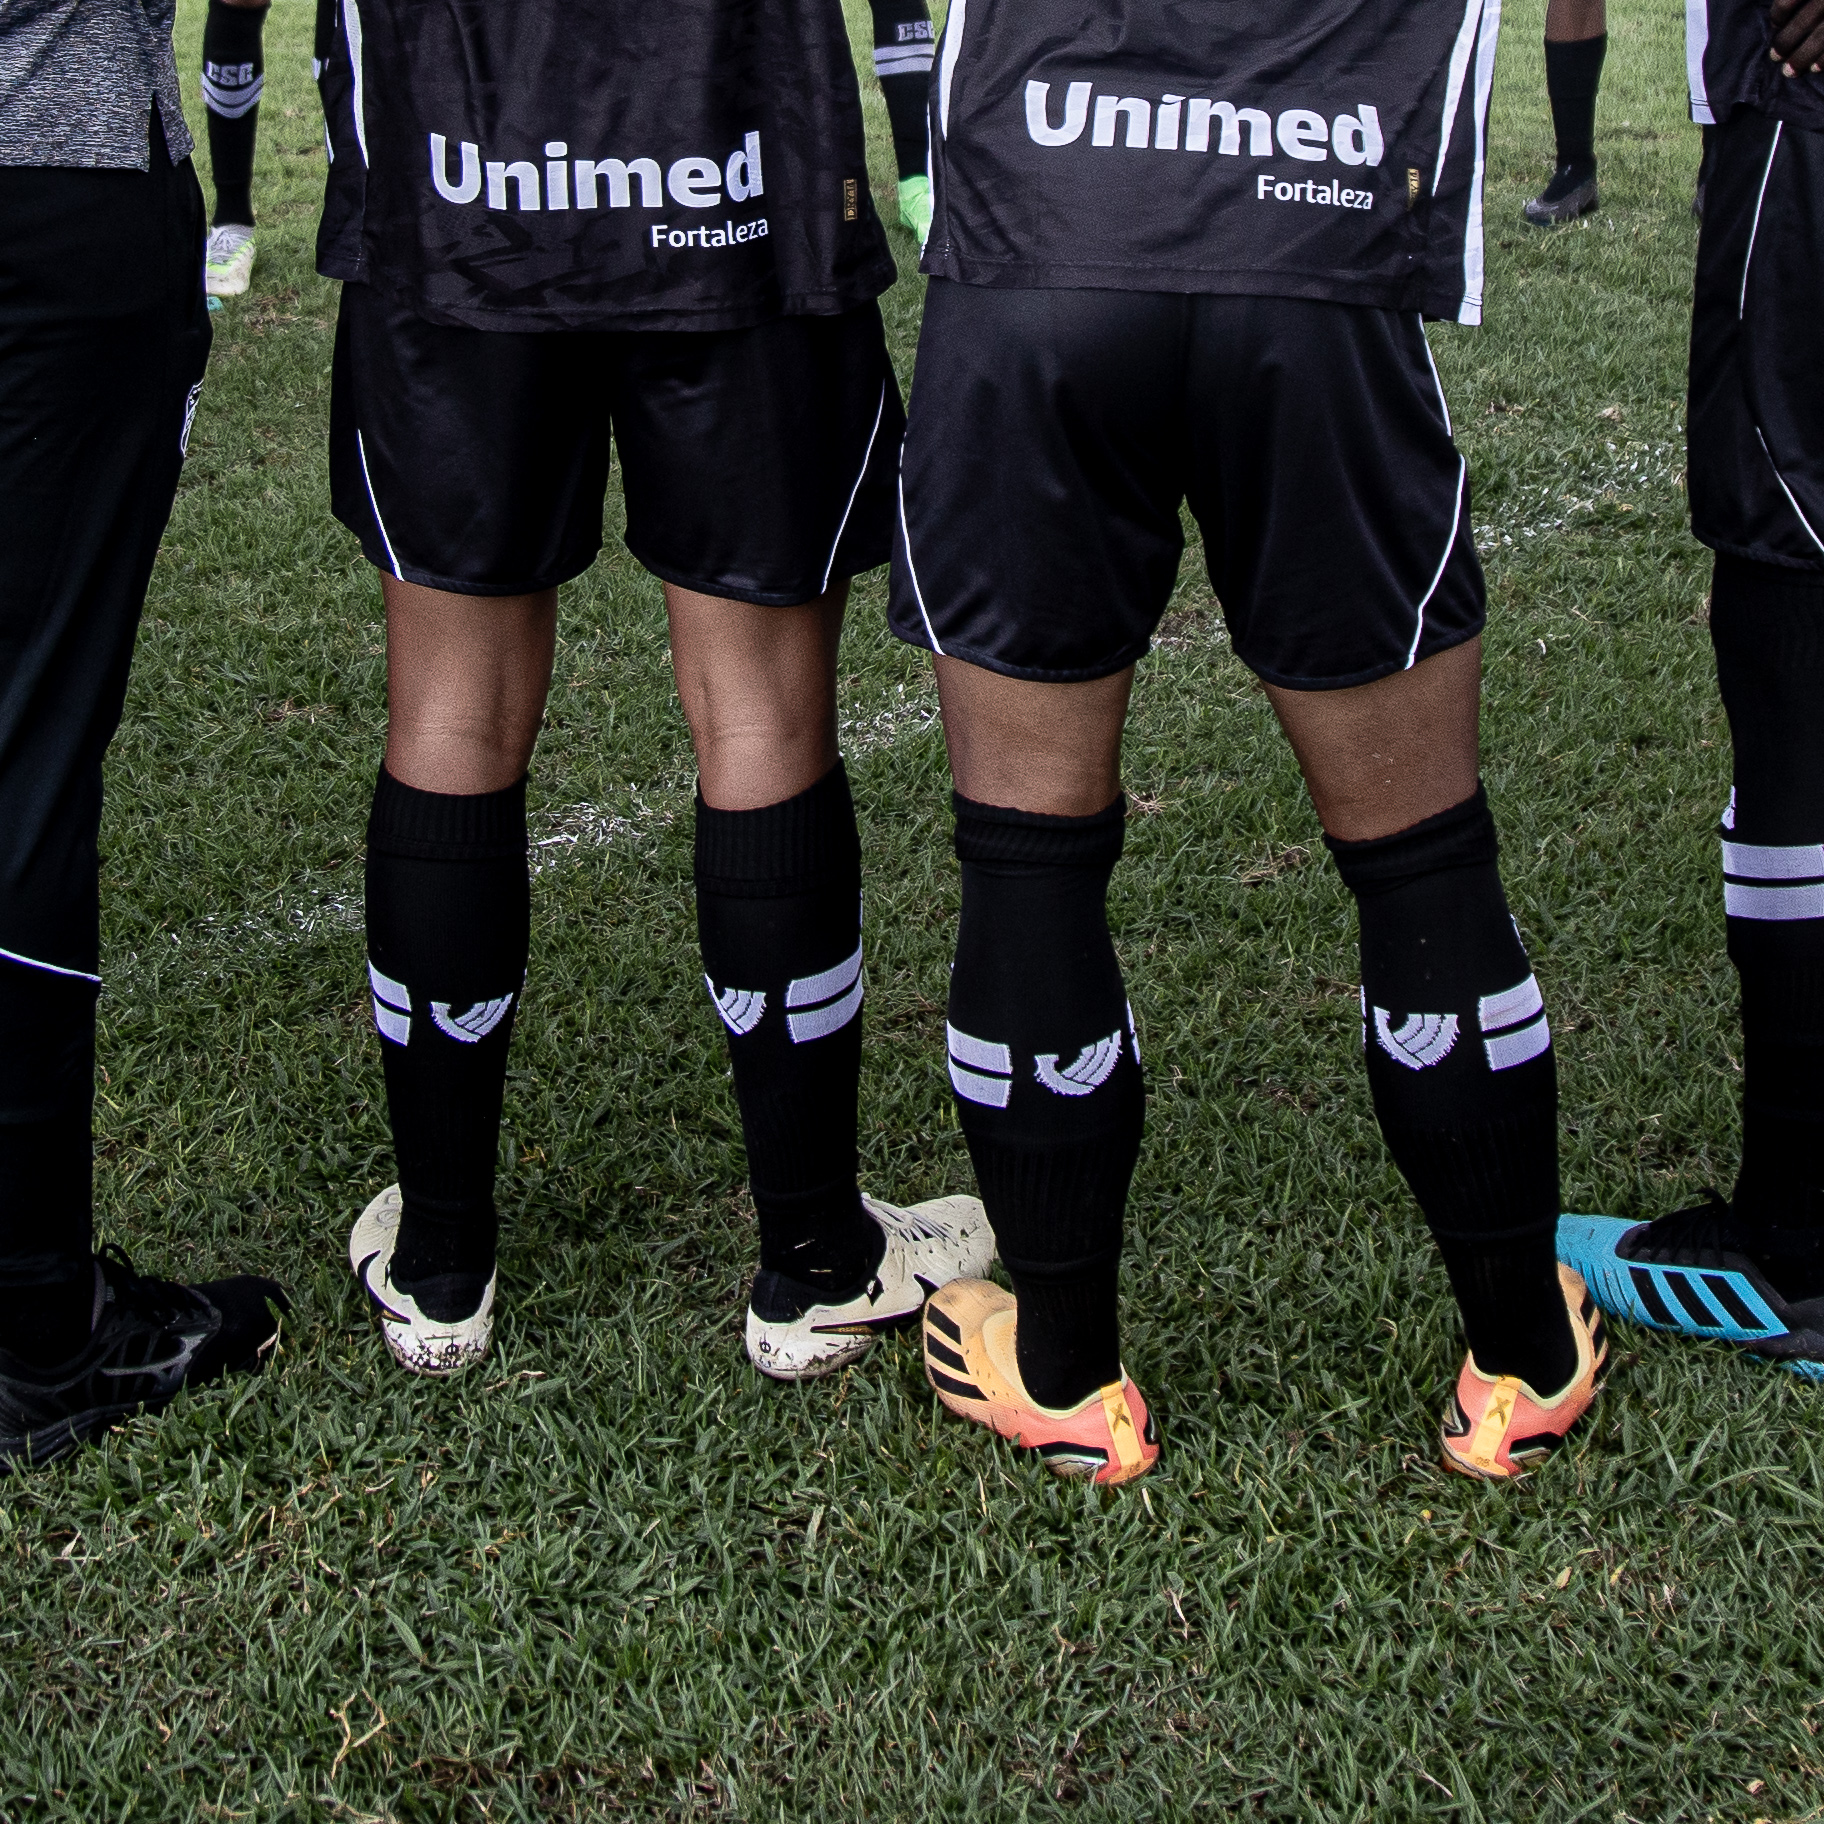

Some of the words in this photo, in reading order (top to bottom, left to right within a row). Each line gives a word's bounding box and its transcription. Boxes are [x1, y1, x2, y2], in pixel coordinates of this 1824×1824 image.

[1024, 79, 1385, 168] Unimed
[430, 130, 765, 212] Unimed
[1256, 174, 1375, 211] Fortaleza
[650, 218, 770, 249] Fortaleza
